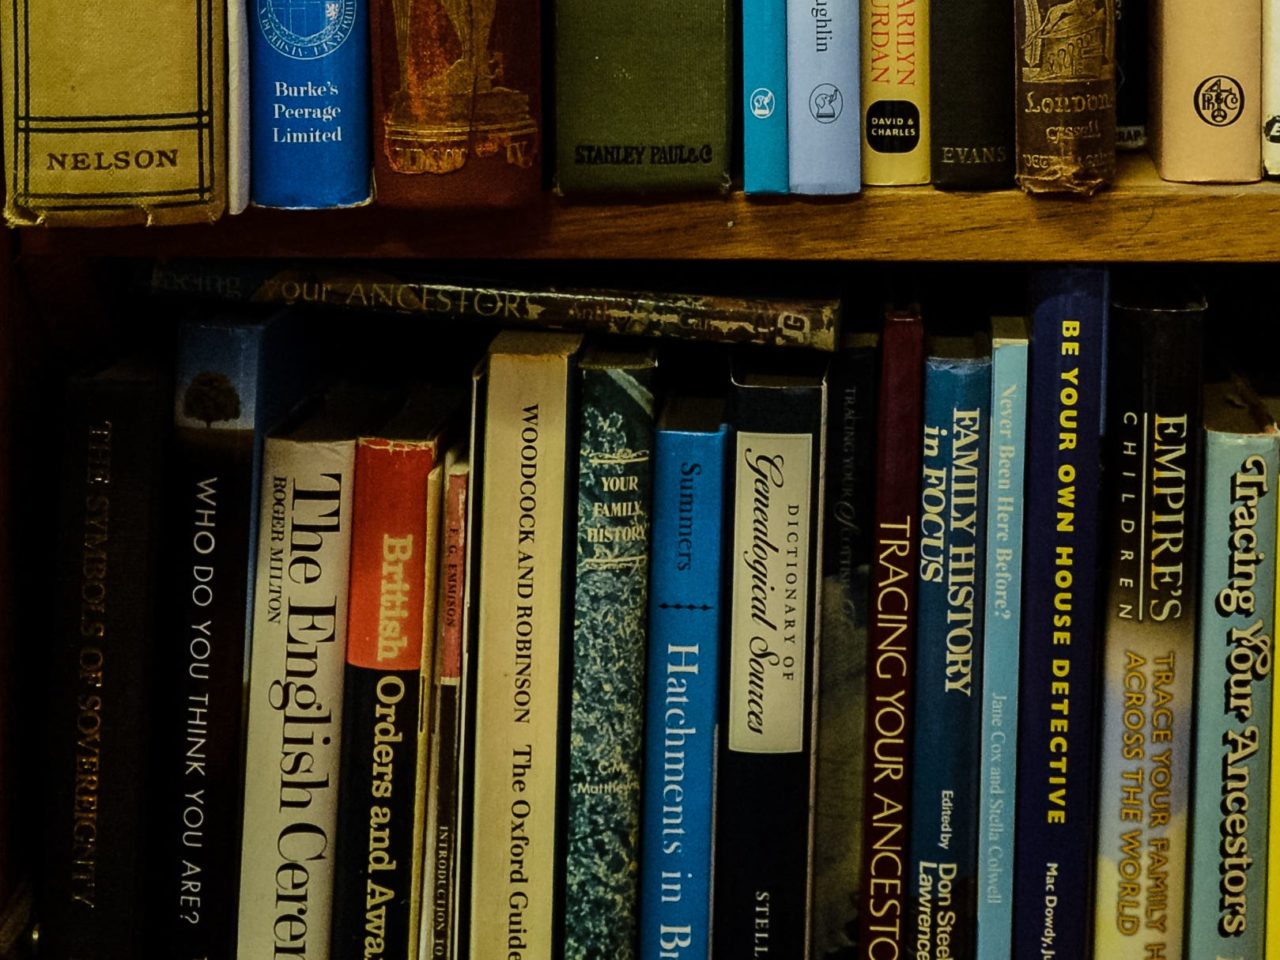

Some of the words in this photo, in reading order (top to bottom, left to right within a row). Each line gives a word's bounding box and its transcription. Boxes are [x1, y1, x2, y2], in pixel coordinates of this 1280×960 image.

[273, 103, 342, 120] Peerage
[275, 81, 339, 96] Burke's
[46, 148, 179, 172] NELSON
[272, 126, 343, 143] Limited
[871, 127, 916, 136] CHARLES
[1061, 320, 1080, 356] BE
[923, 425, 948, 457] in
[1059, 367, 1079, 451] YOUR
[269, 475, 287, 544] ROGER
[518, 403, 539, 543] WOODCOCK
[593, 500, 642, 517] FAMILY
[602, 476, 638, 491] YOUR
[950, 407, 980, 532] FAMILY
[1056, 464, 1076, 533] OWN
[193, 477, 218, 555] WHO
[288, 472, 342, 585] The
[587, 524, 646, 543] HISTORY
[743, 446, 786, 632] Genealogical
[920, 467, 947, 584] FOCUS
[1119, 412, 1137, 620] CHILDREN
[1148, 413, 1188, 622] EMPIRE'S
[1215, 453, 1268, 618] Tracing
[192, 565, 214, 607] DO
[267, 548, 285, 624] MILTON
[376, 533, 415, 663] British
[516, 549, 534, 599] AND
[783, 503, 801, 646] DICTIONARY
[876, 515, 911, 680] TRACING
[1052, 547, 1073, 645] HOUSE
[189, 620, 211, 679] YOU
[944, 543, 977, 697] HISTORY
[268, 594, 338, 813] English
[513, 604, 534, 724] ROBINSON
[746, 636, 781, 736] Sources
[782, 656, 795, 682] OF
[1121, 651, 1147, 760] ACROSS
[1149, 651, 1174, 745] TRACE
[1224, 619, 1273, 735] Your
[185, 693, 210, 776] THINK
[371, 675, 405, 799] Orders
[512, 744, 532, 793] The
[662, 642, 699, 856] Hatchments
[873, 690, 906, 781] YOUR
[1047, 660, 1070, 824] DETECTIVE
[181, 790, 205, 848] YOU
[1120, 768, 1144, 822] THE
[1147, 751, 1172, 829] YOUR
[1217, 724, 1259, 938] Ancestors
[368, 809, 398, 874] and
[509, 799, 531, 884] Oxford
[869, 791, 904, 960] ANCESTO
[178, 859, 201, 925] ARE?
[364, 879, 395, 960] Awa
[508, 890, 529, 960] Guide
[661, 871, 693, 903] in
[1116, 832, 1141, 937] WORLD
[1144, 838, 1170, 934] FAMILY
